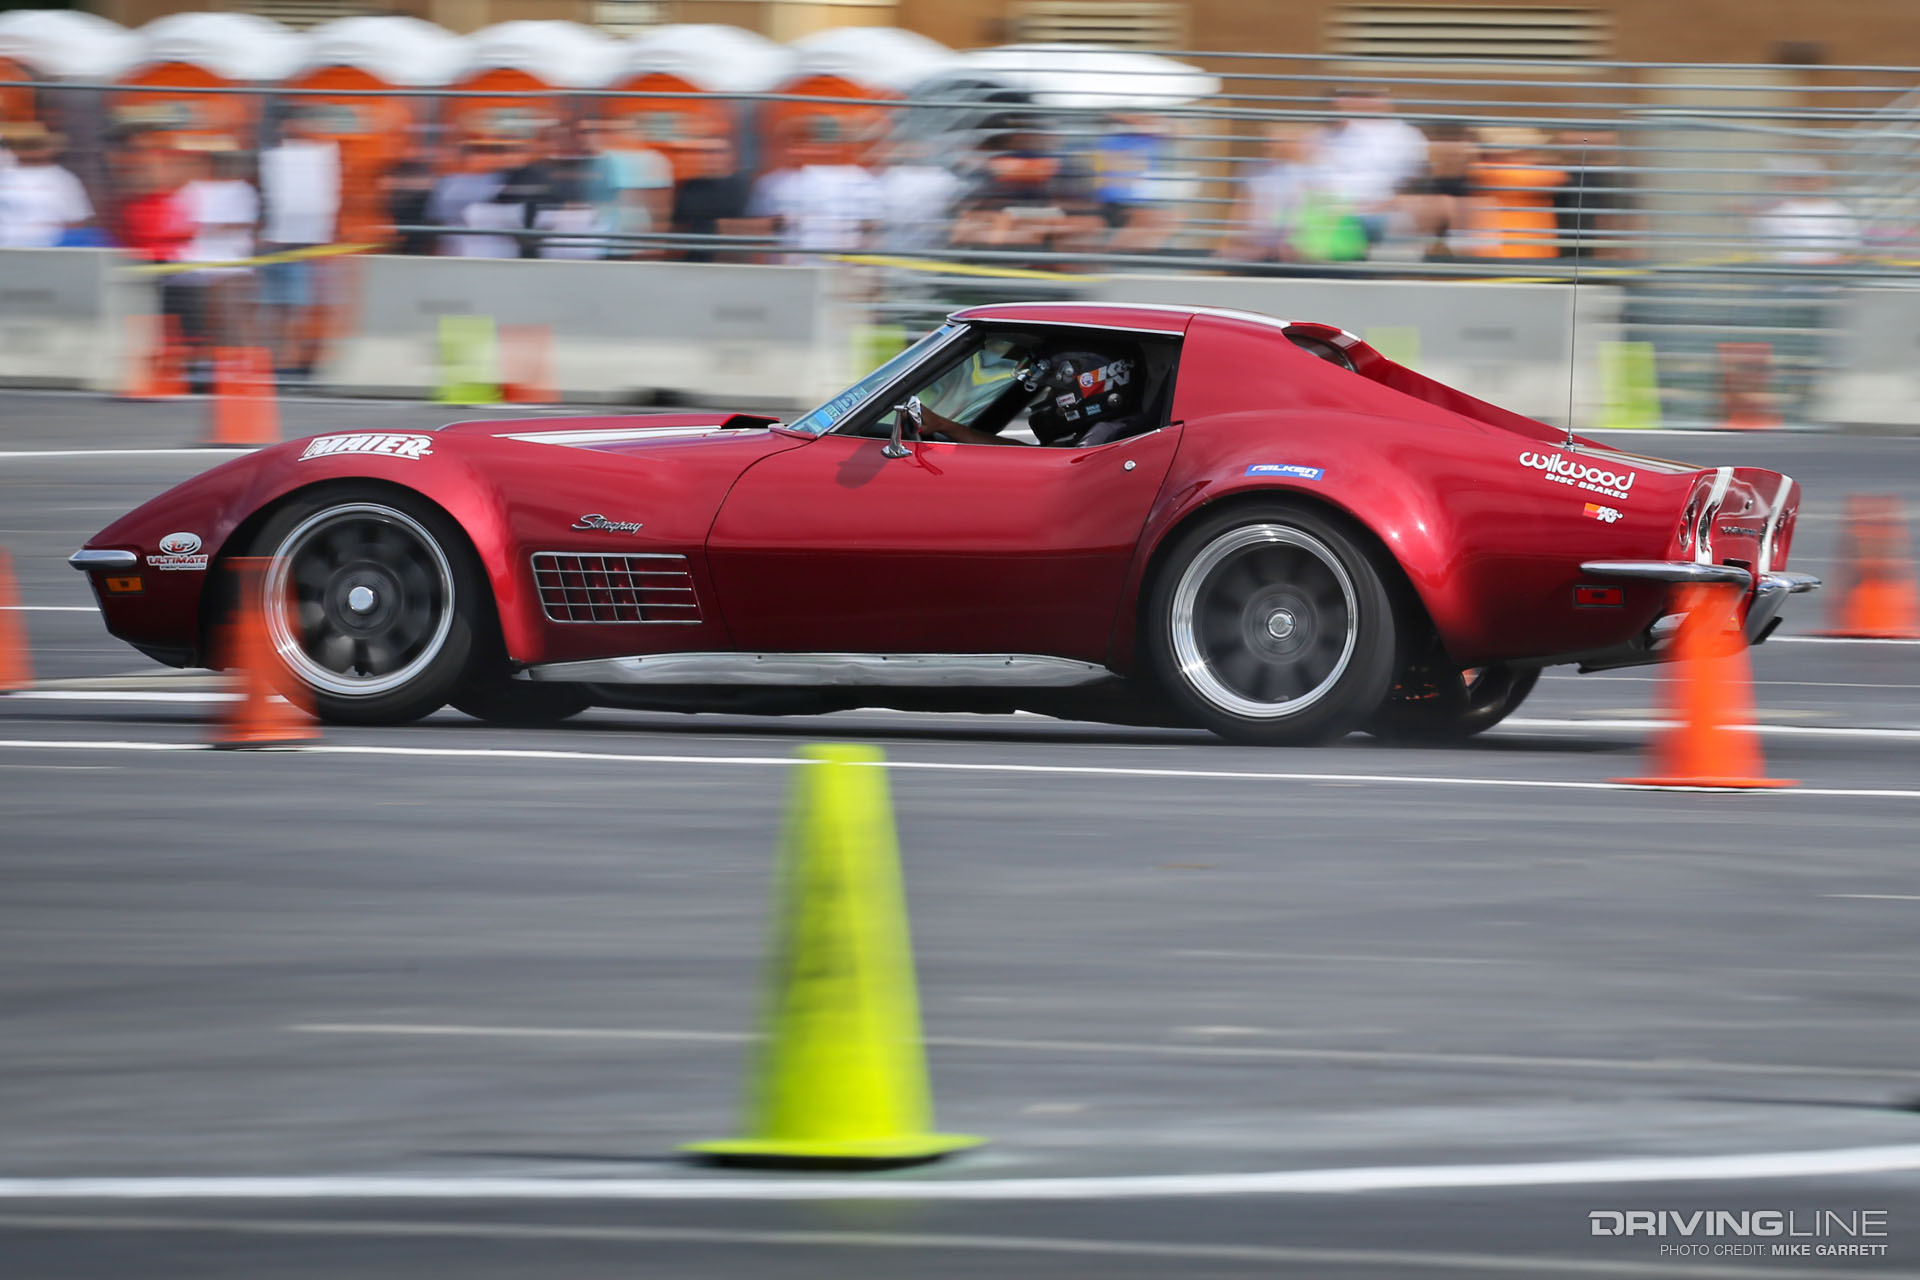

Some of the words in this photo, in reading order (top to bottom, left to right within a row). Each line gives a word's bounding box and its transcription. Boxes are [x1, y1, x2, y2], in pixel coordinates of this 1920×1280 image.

[311, 435, 433, 458] MAIER
[1251, 464, 1319, 476] FALKEN
[1519, 451, 1636, 491] wilwood
[1544, 473, 1576, 486] DISC
[1577, 481, 1629, 500] BRAKES
[571, 513, 644, 535] Stingray
[148, 555, 208, 565] ULTIMATE
